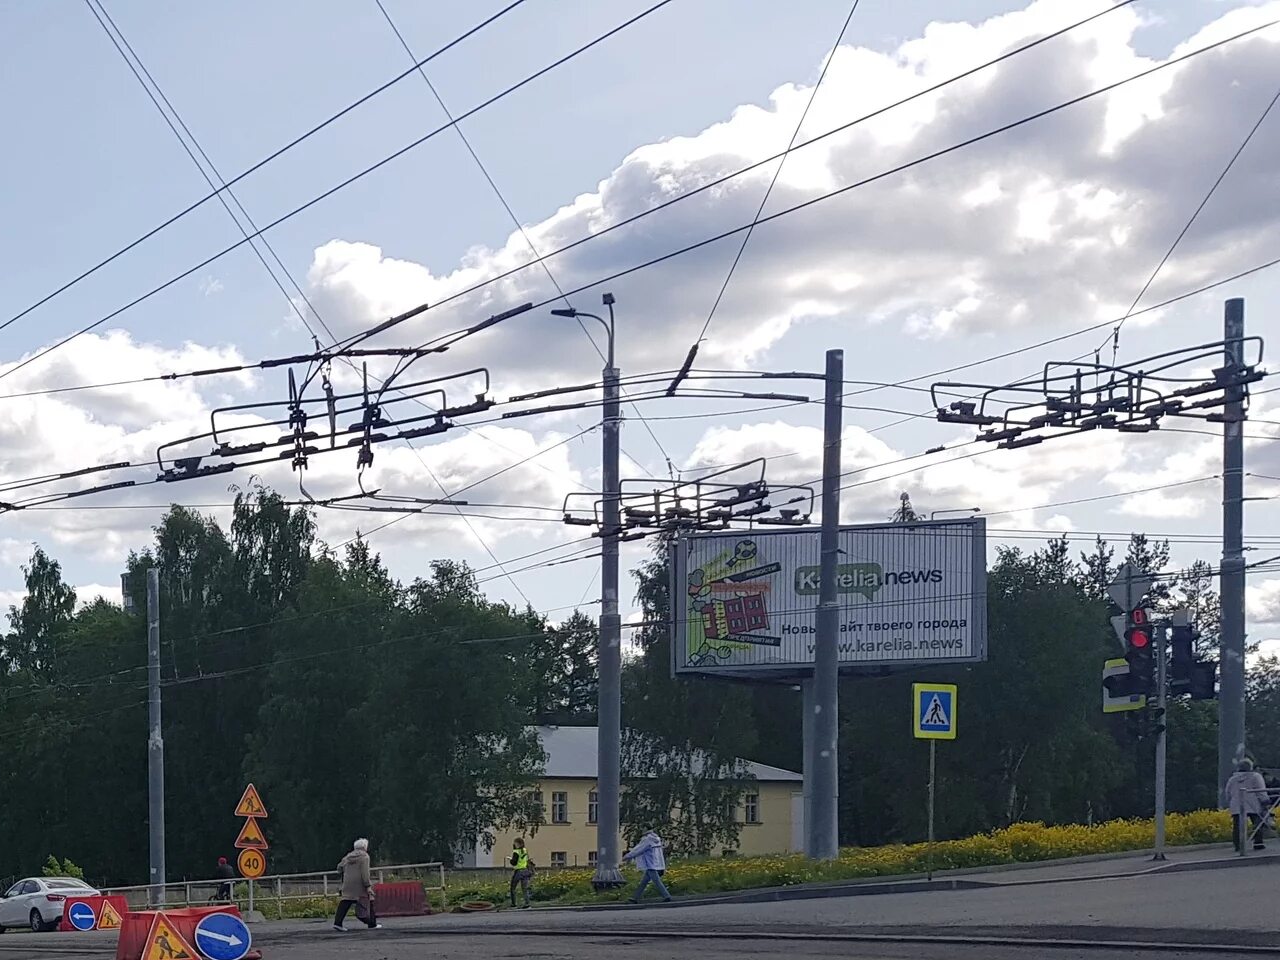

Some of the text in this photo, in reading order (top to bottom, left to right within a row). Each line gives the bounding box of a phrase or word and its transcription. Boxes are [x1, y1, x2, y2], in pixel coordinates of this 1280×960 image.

[782, 618, 967, 635] Новы айт твоего города
[244, 858, 259, 870] 40
